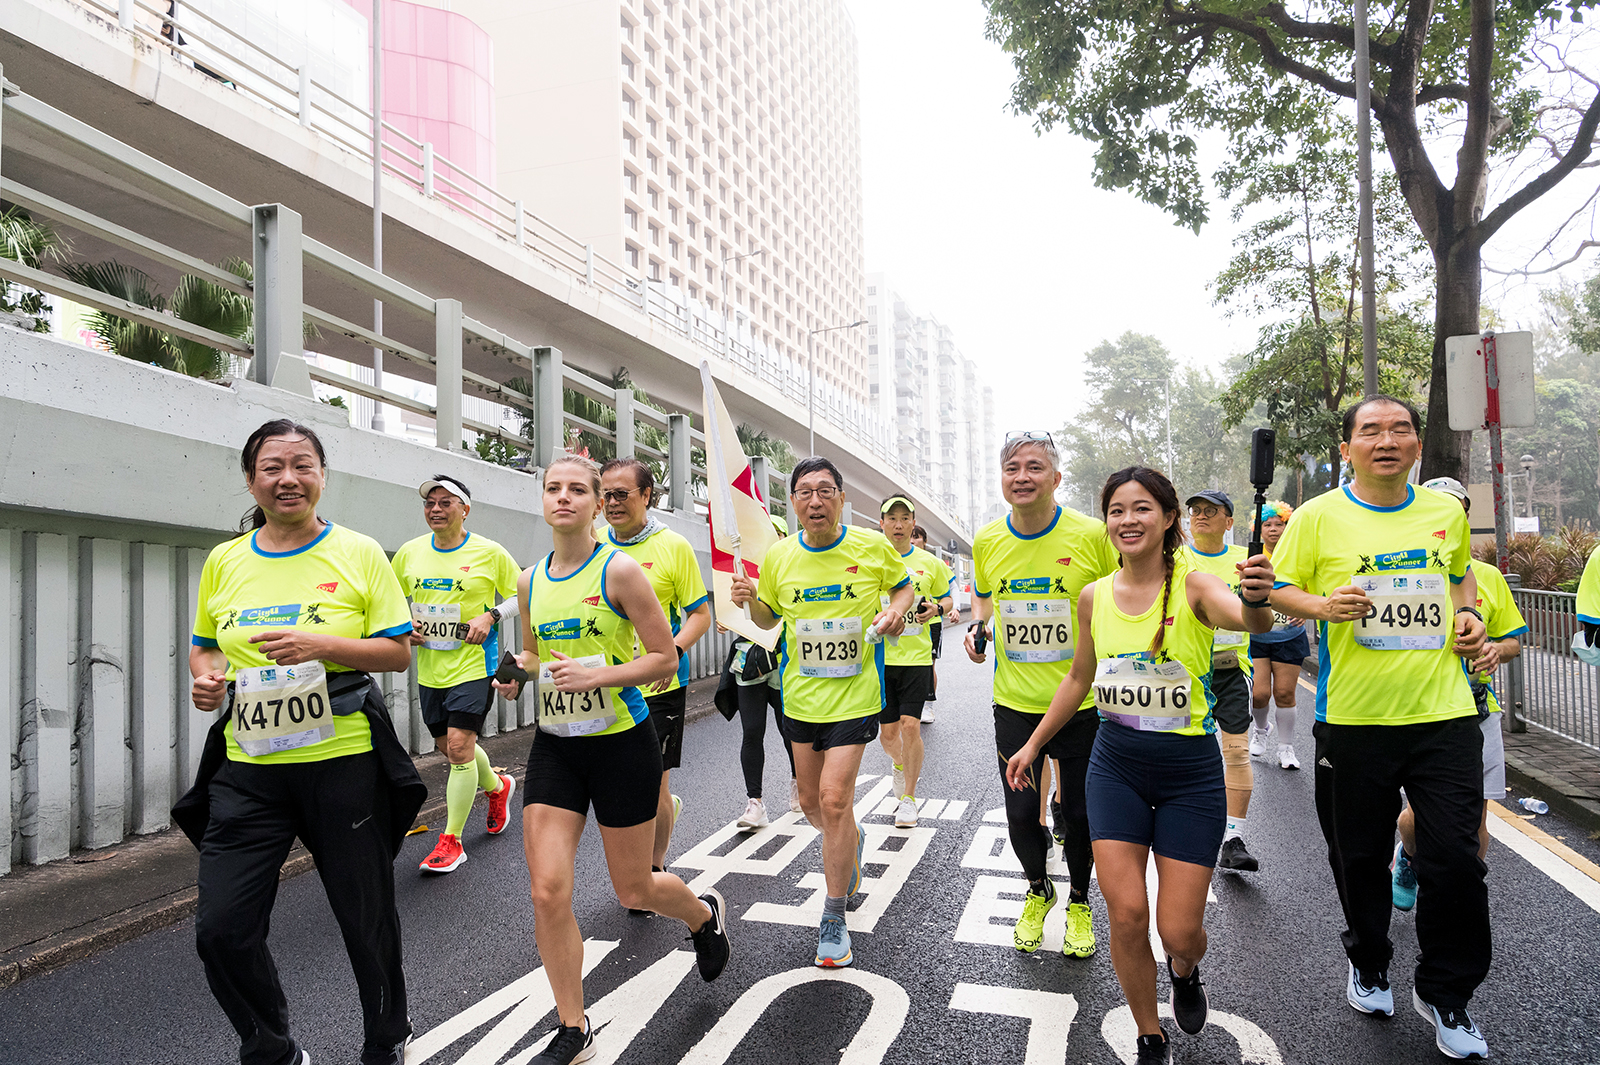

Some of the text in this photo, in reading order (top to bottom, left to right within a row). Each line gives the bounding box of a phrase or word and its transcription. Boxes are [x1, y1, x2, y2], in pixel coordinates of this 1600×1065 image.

[1382, 551, 1409, 565] CityU
[1389, 559, 1421, 569] Runner
[1016, 579, 1036, 589] CityU
[809, 587, 828, 597] CityU
[247, 607, 279, 620] CityU
[252, 616, 292, 625] Runner
[1361, 603, 1441, 628] P4943
[544, 621, 565, 635] CityU
[550, 630, 575, 639] Runner
[1006, 623, 1068, 645] P2076
[802, 640, 858, 661] P1239
[543, 687, 605, 716] K4731
[1098, 685, 1187, 709] M5016
[237, 692, 324, 731] K4700
